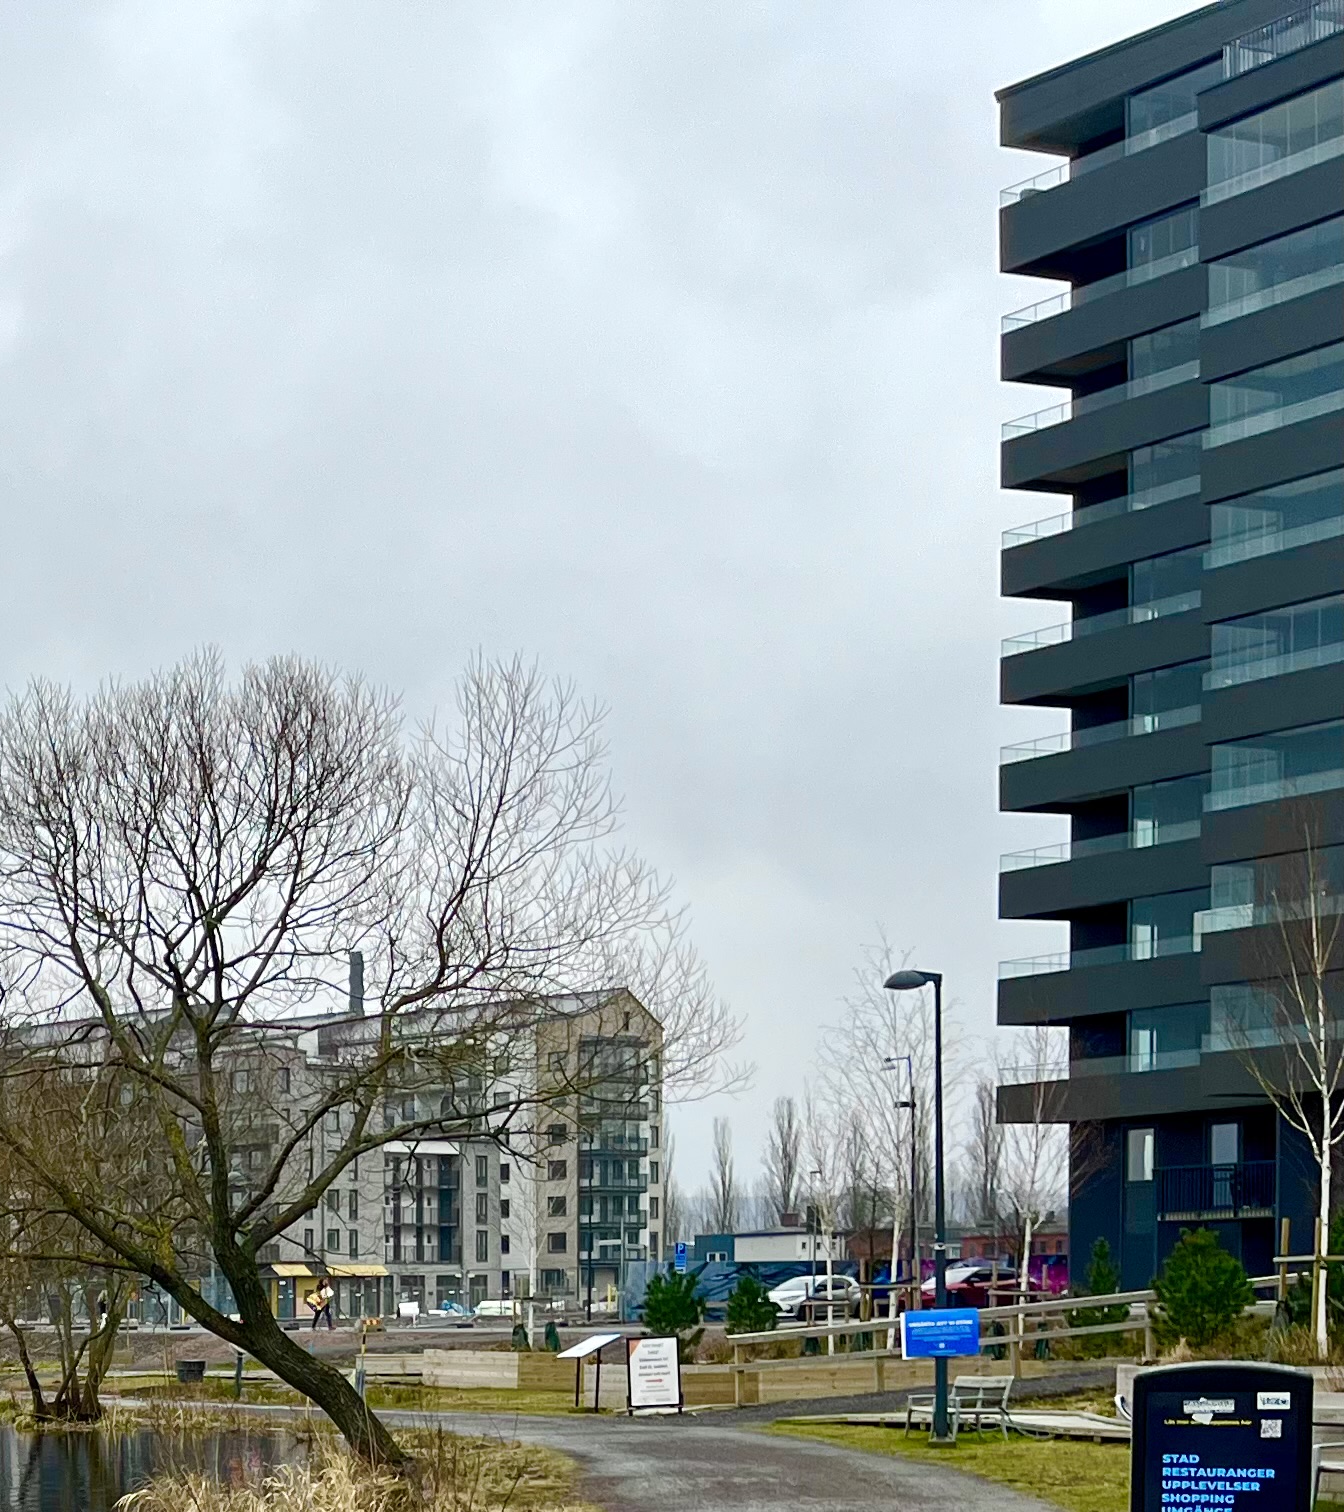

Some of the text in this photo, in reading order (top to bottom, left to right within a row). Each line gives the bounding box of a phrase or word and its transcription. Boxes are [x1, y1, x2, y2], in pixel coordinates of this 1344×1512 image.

[677, 1242, 685, 1253] P
[1162, 1454, 1200, 1464] STAD
[1162, 1467, 1275, 1478] RESTAURANGER
[1161, 1480, 1260, 1491] UPPLEVELSER
[1161, 1493, 1235, 1504] SHOPPING
